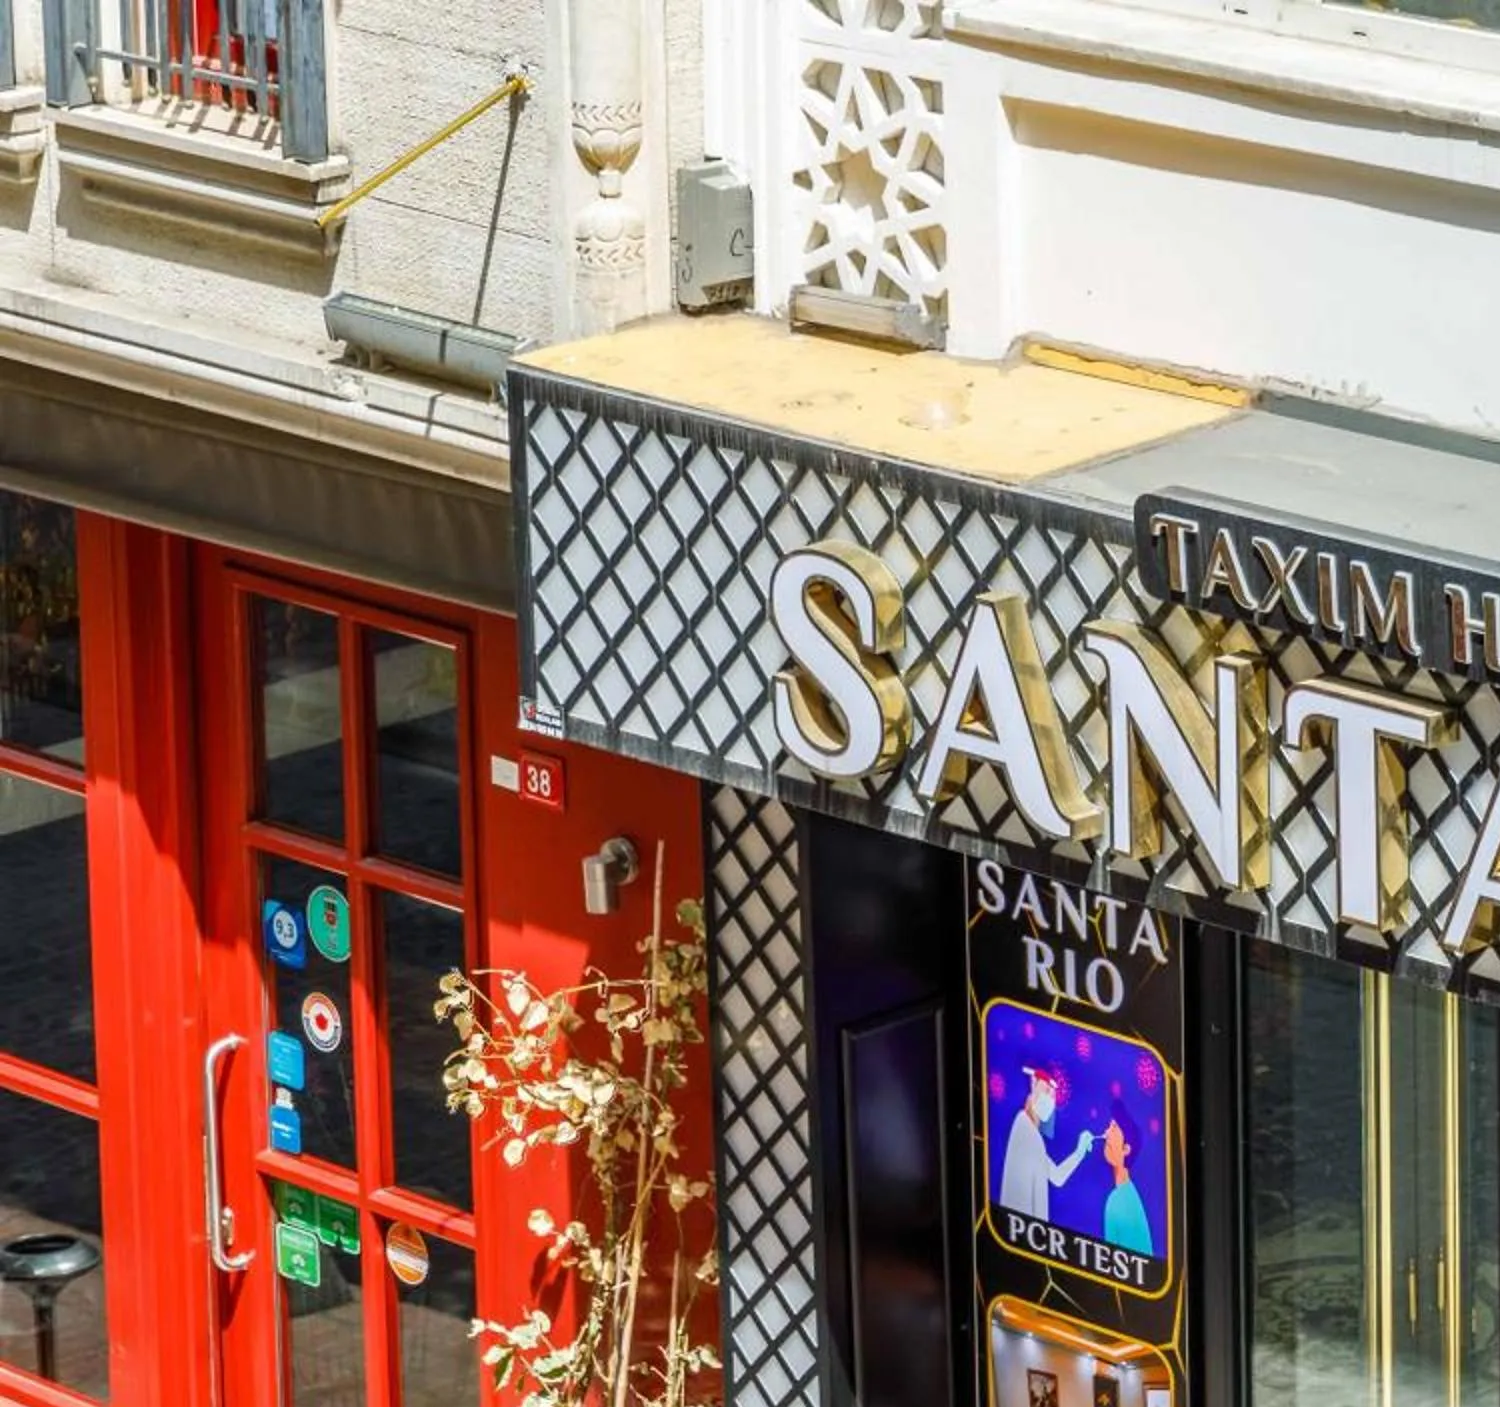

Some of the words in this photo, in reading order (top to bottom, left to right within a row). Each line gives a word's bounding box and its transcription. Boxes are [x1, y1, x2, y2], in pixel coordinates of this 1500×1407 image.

[1150, 513, 1424, 659] TAXIM
[527, 765, 551, 797] 38
[977, 859, 1169, 964] SANTA
[1022, 935, 1125, 1013] RIO
[1007, 1212, 1069, 1263] PCR
[1073, 1233, 1149, 1287] TEST
